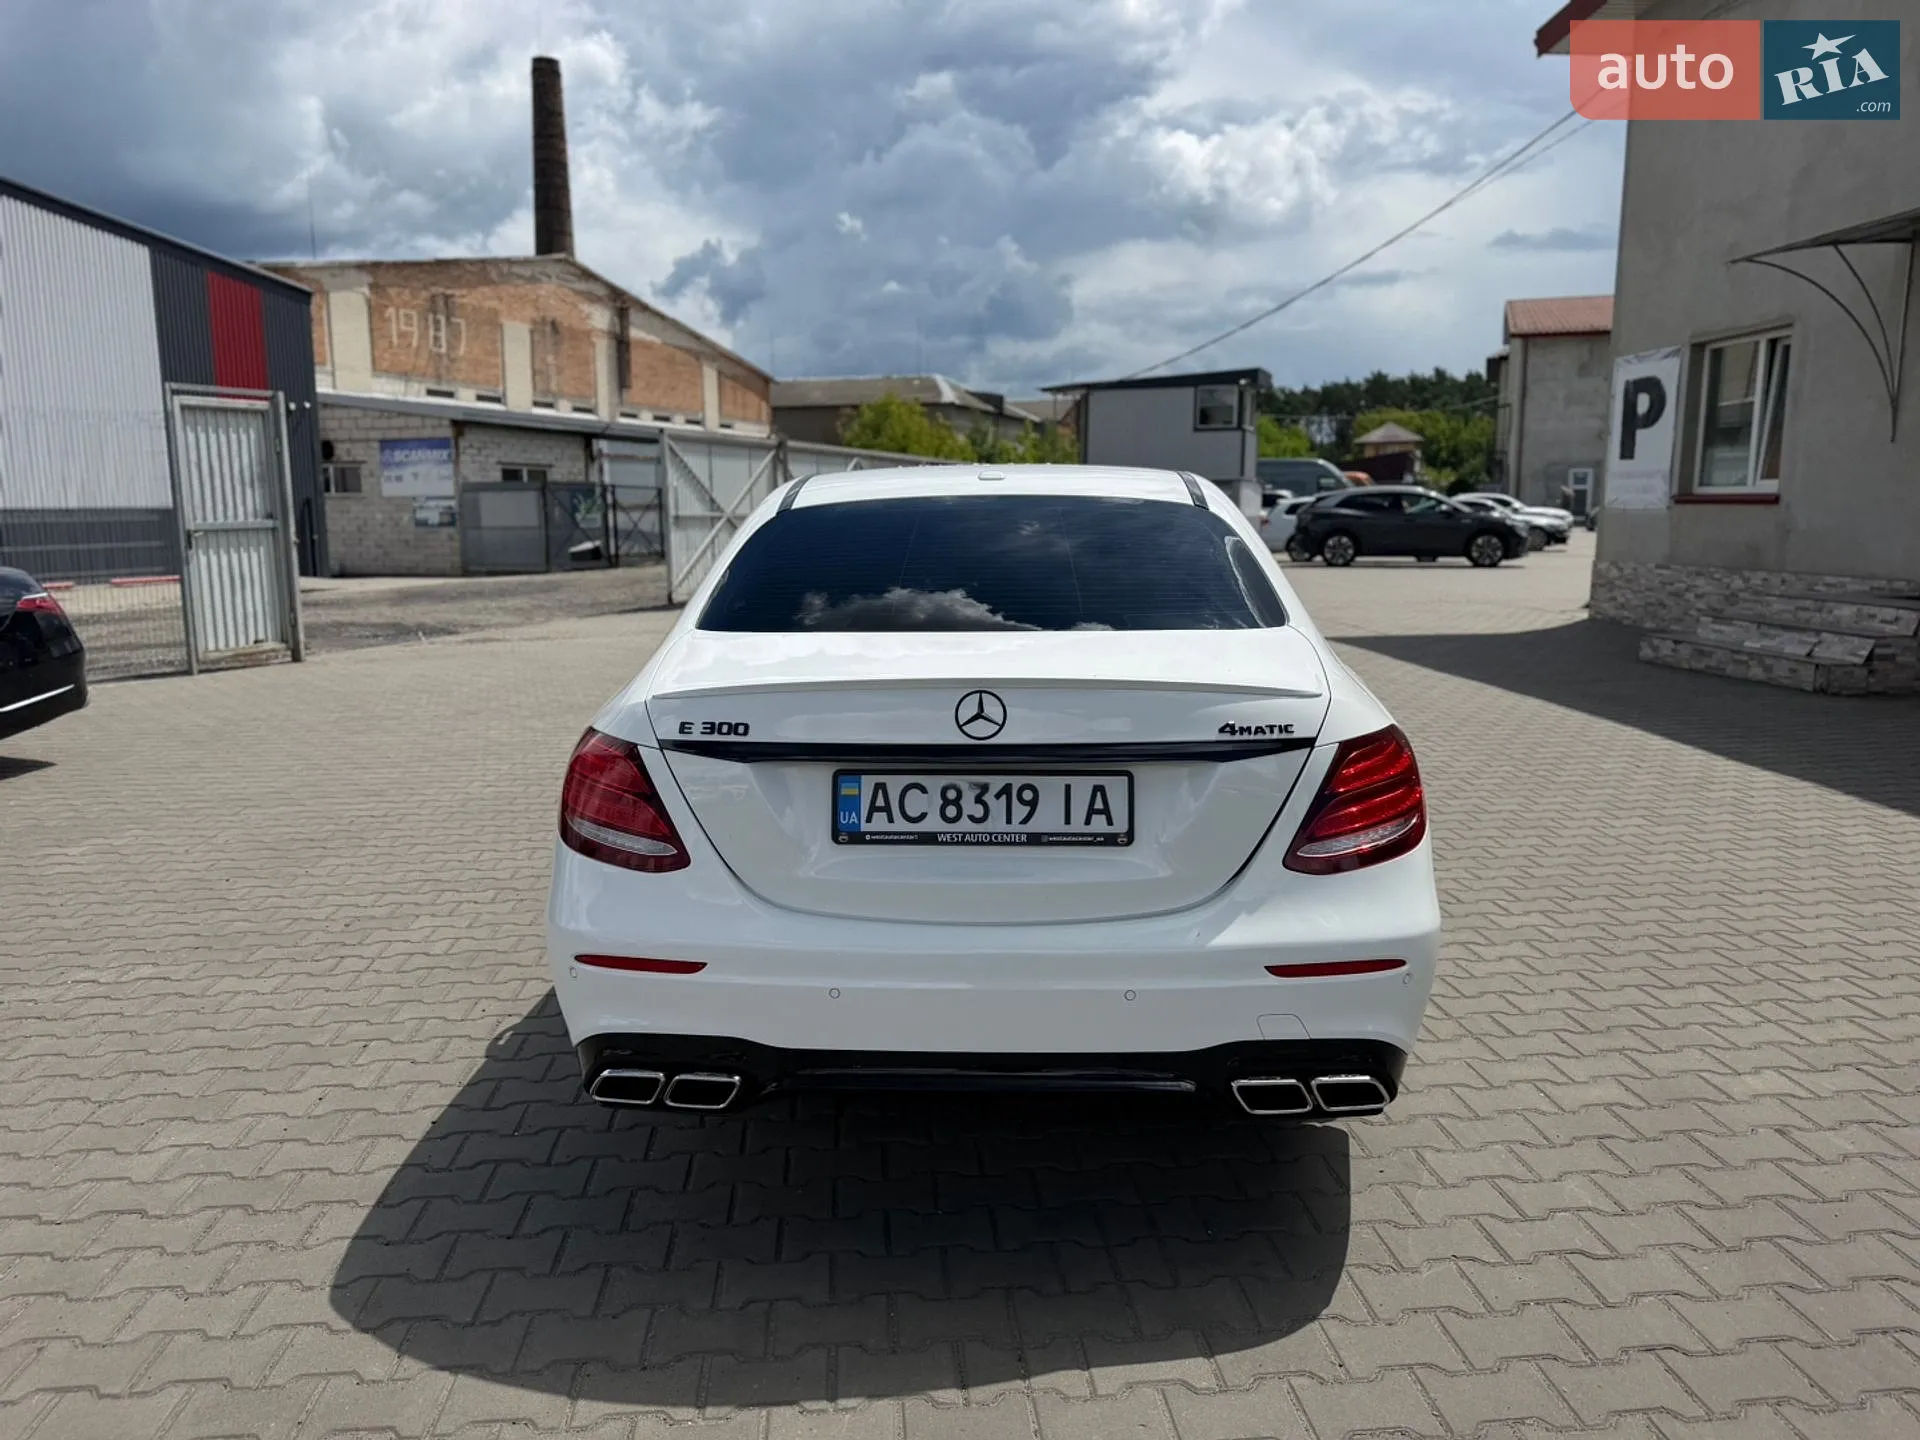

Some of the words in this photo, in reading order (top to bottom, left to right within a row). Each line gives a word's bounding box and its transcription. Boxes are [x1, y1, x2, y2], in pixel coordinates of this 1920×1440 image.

[1619, 375, 1667, 460] P
[678, 721, 695, 735] E
[700, 721, 750, 737] 300
[1218, 721, 1295, 736] 4MATIC
[865, 782, 929, 824] AC
[939, 782, 1040, 825] 8319
[1063, 783, 1115, 827] IA
[839, 810, 859, 825] UA
[937, 833, 963, 843] WEST
[964, 833, 990, 843] AUTO
[991, 833, 1028, 843] CENTER
